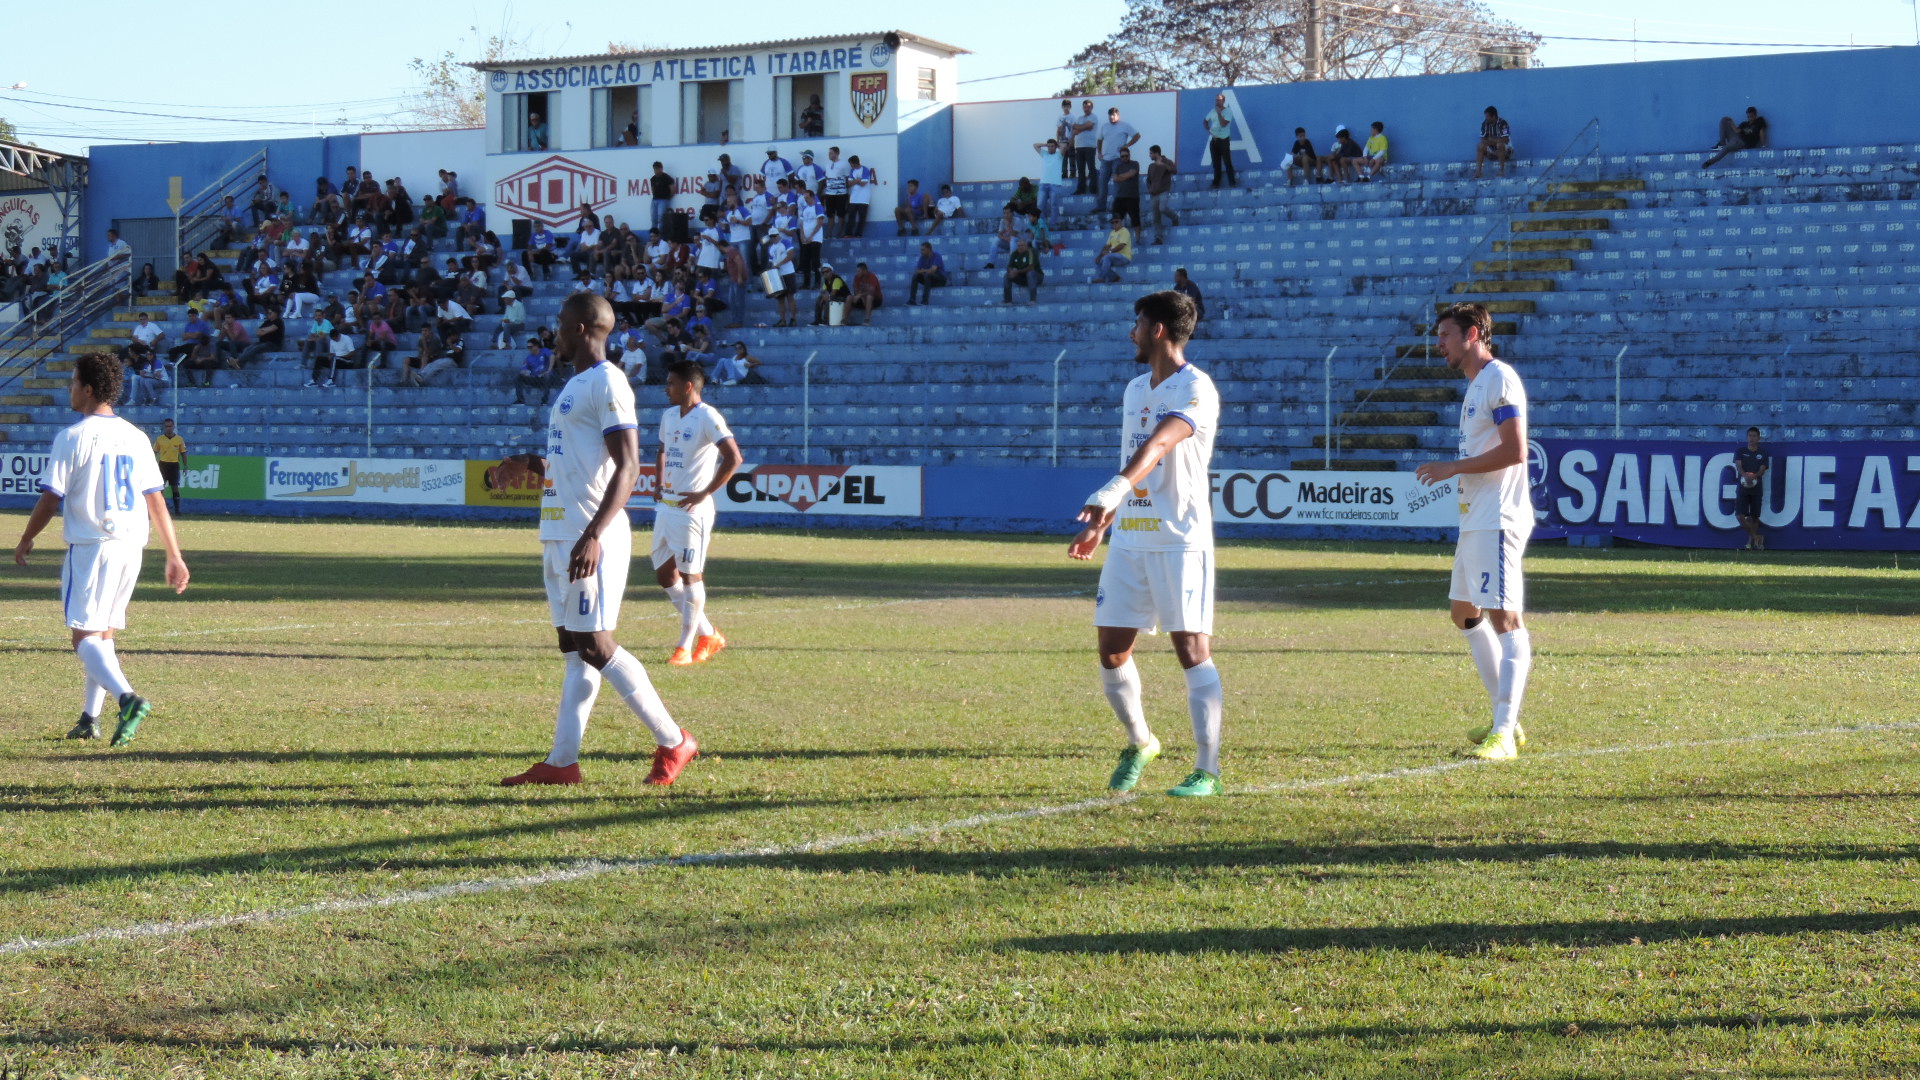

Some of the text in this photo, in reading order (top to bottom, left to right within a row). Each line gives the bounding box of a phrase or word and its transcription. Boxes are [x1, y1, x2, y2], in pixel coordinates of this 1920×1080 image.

[515, 43, 862, 91] ASSOCIAÇÃO ATLETICA ITARARÉ
[857, 77, 882, 90] FPF
[496, 168, 617, 214] INCOMIL
[1766, 206, 1783, 215] 1657
[1846, 204, 1864, 212] 1660
[1900, 202, 1918, 211] 1662
[1750, 227, 1767, 235] 1525
[1776, 226, 1793, 234] 1526
[1804, 225, 1821, 234] 1527
[1859, 224, 1875, 232] 1529
[1886, 223, 1904, 232] 1530
[99, 453, 135, 512] 18
[269, 460, 420, 497] Ferragens Jacopetti
[725, 472, 886, 505] CIPAPEL
[1557, 449, 1836, 529] SANGUE
[1208, 472, 1394, 520] FCC Madeiras
[1407, 483, 1452, 514] 3531-3178
[1480, 571, 1490, 594] 2
[578, 590, 590, 616] 6
